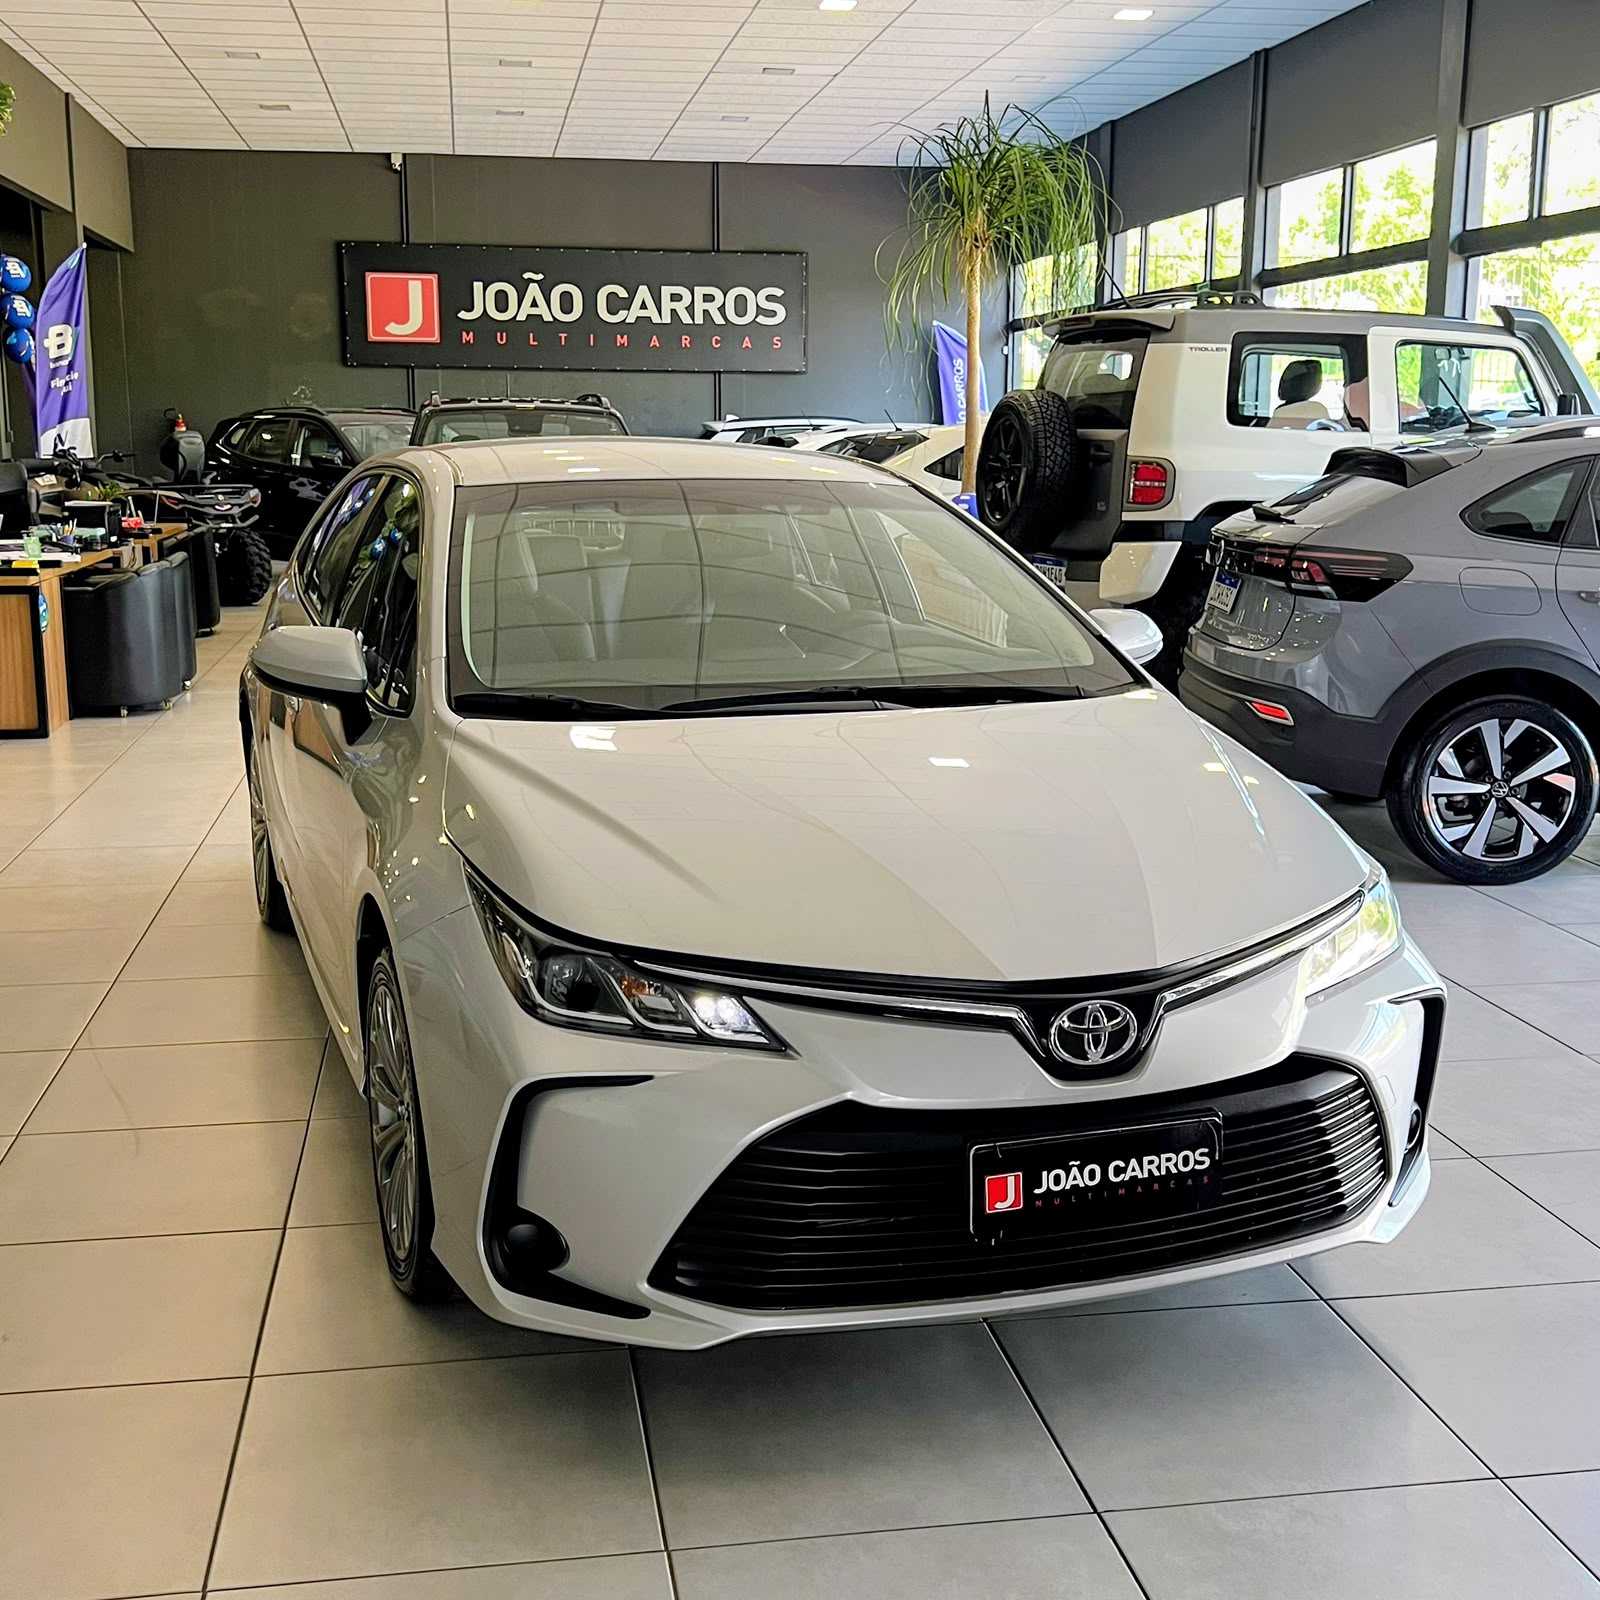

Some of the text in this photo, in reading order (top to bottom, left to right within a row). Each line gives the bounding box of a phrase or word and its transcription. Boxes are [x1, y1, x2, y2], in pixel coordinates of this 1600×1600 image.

[384, 279, 423, 336] J
[456, 271, 787, 326] JOÃO CARROS
[461, 330, 783, 349] MULTIMARCAS
[994, 1175, 1015, 1209] J
[1033, 1147, 1211, 1194] JOÃO CARROS
